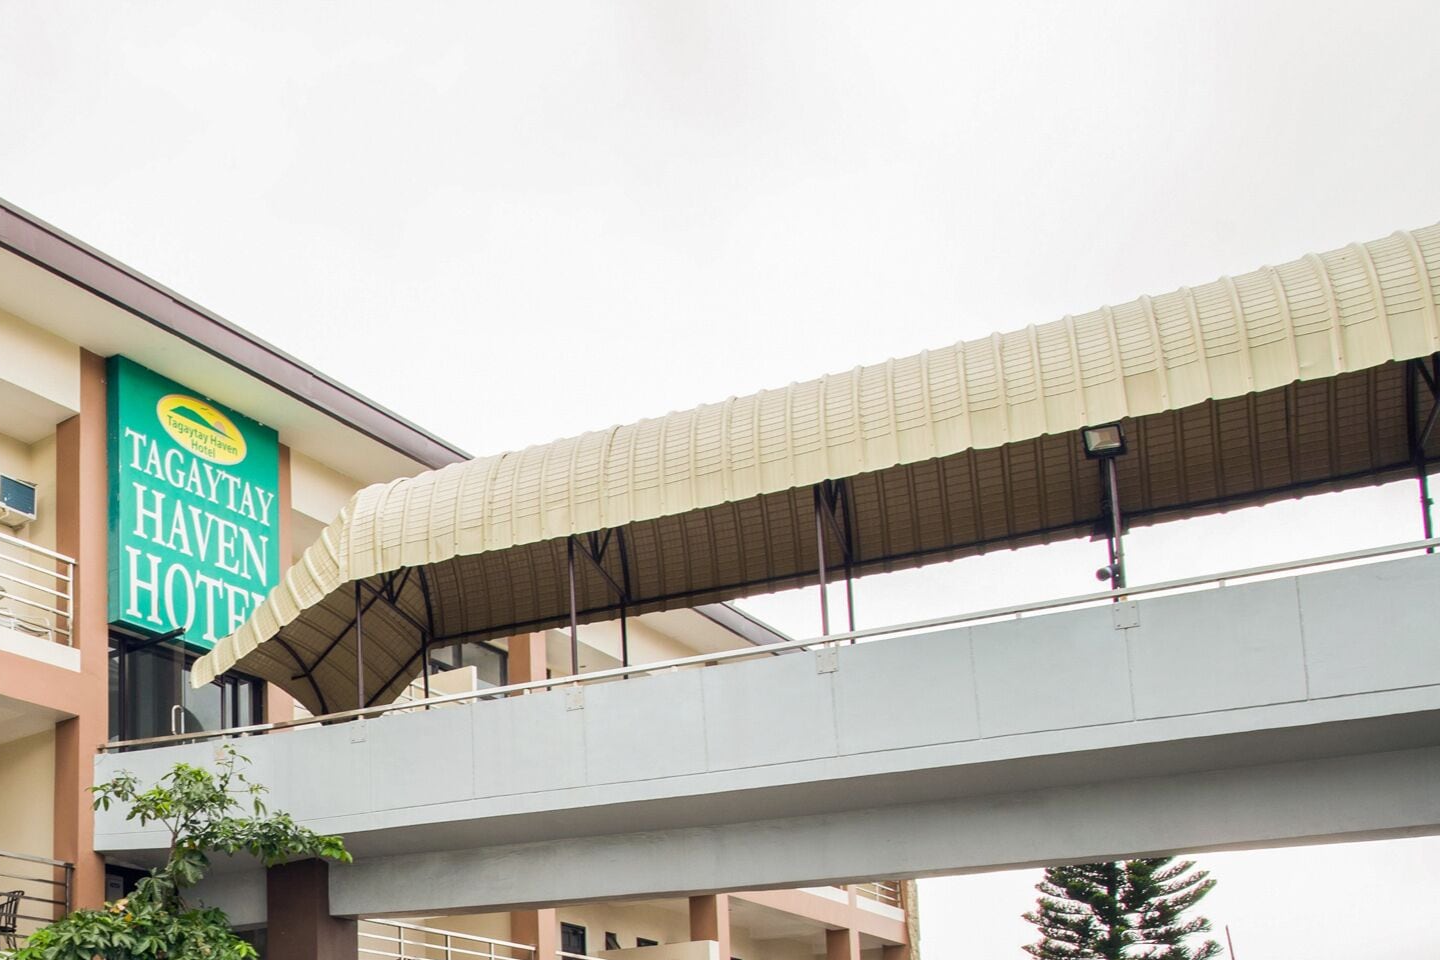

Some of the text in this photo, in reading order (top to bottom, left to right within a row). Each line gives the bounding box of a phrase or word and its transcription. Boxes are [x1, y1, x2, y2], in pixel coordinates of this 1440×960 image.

[167, 414, 238, 456] Tagaytay Haven
[191, 439, 216, 458] Hotel
[125, 427, 274, 527] TAGAYTAY
[132, 481, 269, 587] HAVEN
